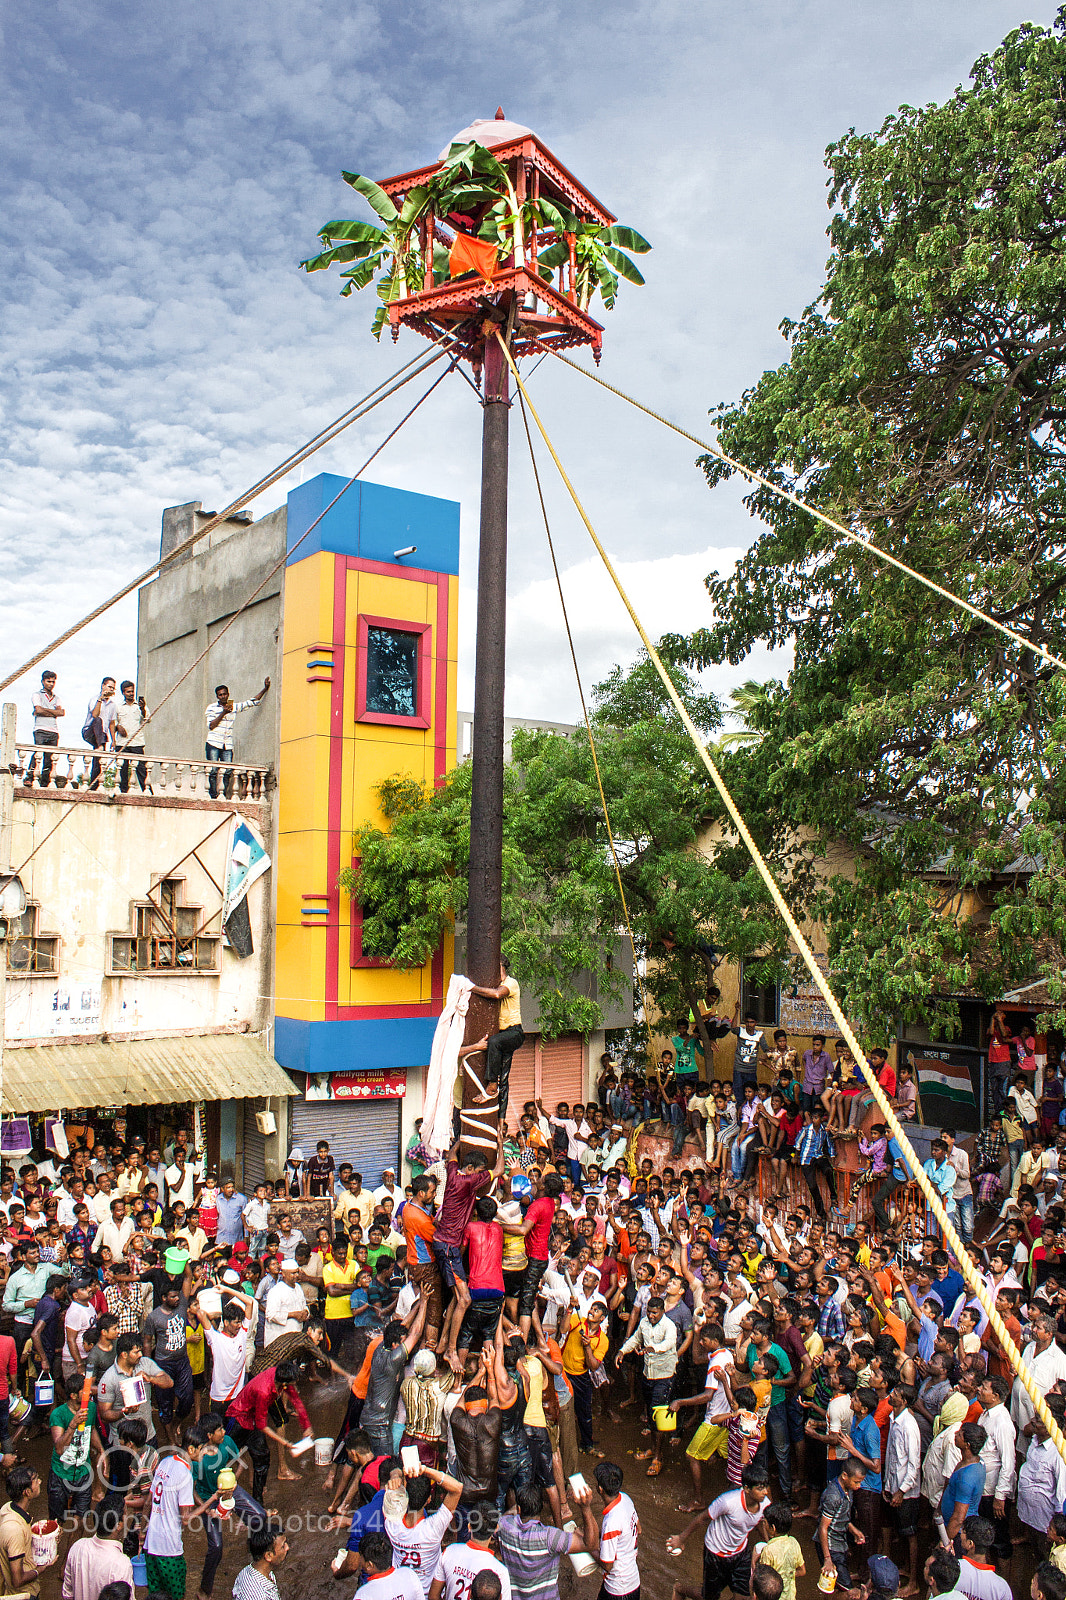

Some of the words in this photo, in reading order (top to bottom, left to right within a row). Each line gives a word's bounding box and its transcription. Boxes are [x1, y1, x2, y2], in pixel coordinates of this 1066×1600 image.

[367, 1069, 385, 1077] milk
[167, 1314, 180, 1329] EAT
[101, 1383, 106, 1395] 3
[153, 1481, 163, 1504] 9
[400, 1550, 421, 1569] 29
